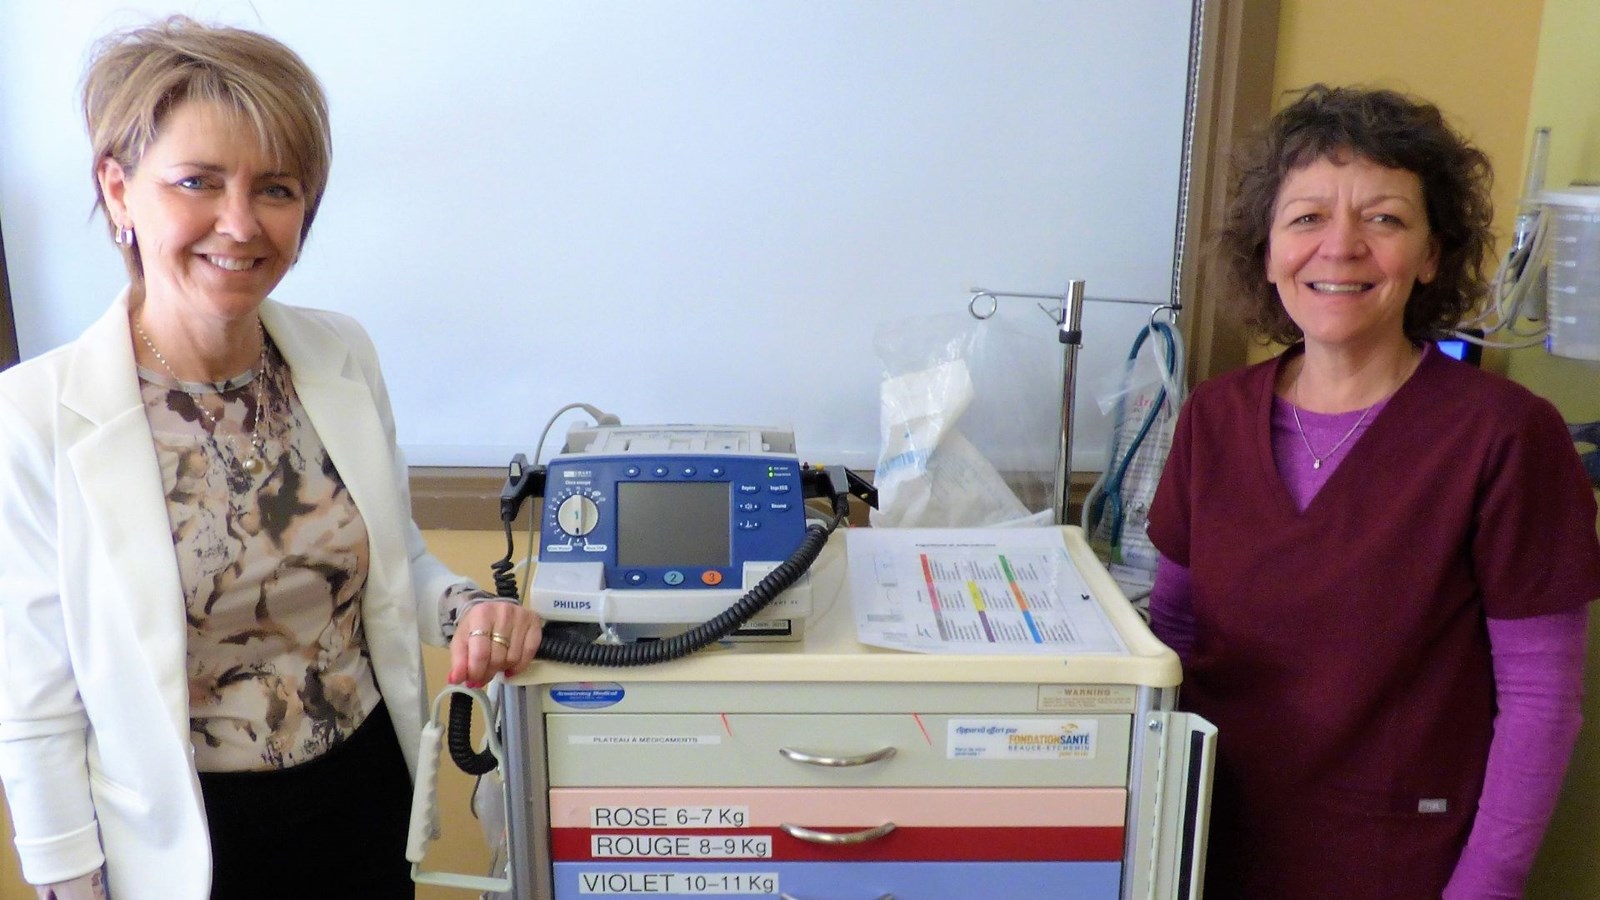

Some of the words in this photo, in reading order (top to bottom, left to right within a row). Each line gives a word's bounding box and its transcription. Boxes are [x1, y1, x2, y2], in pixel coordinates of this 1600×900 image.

[670, 572, 677, 583] 2
[708, 572, 715, 583] 3
[553, 600, 592, 610] PHILIPS
[1064, 688, 1111, 696] WARNING
[594, 807, 668, 827] ROSE
[718, 808, 744, 828] Kg
[596, 836, 690, 856] ROUGE
[741, 838, 767, 857] Kg
[582, 873, 675, 893] VIOLET
[748, 875, 774, 893] Kg
